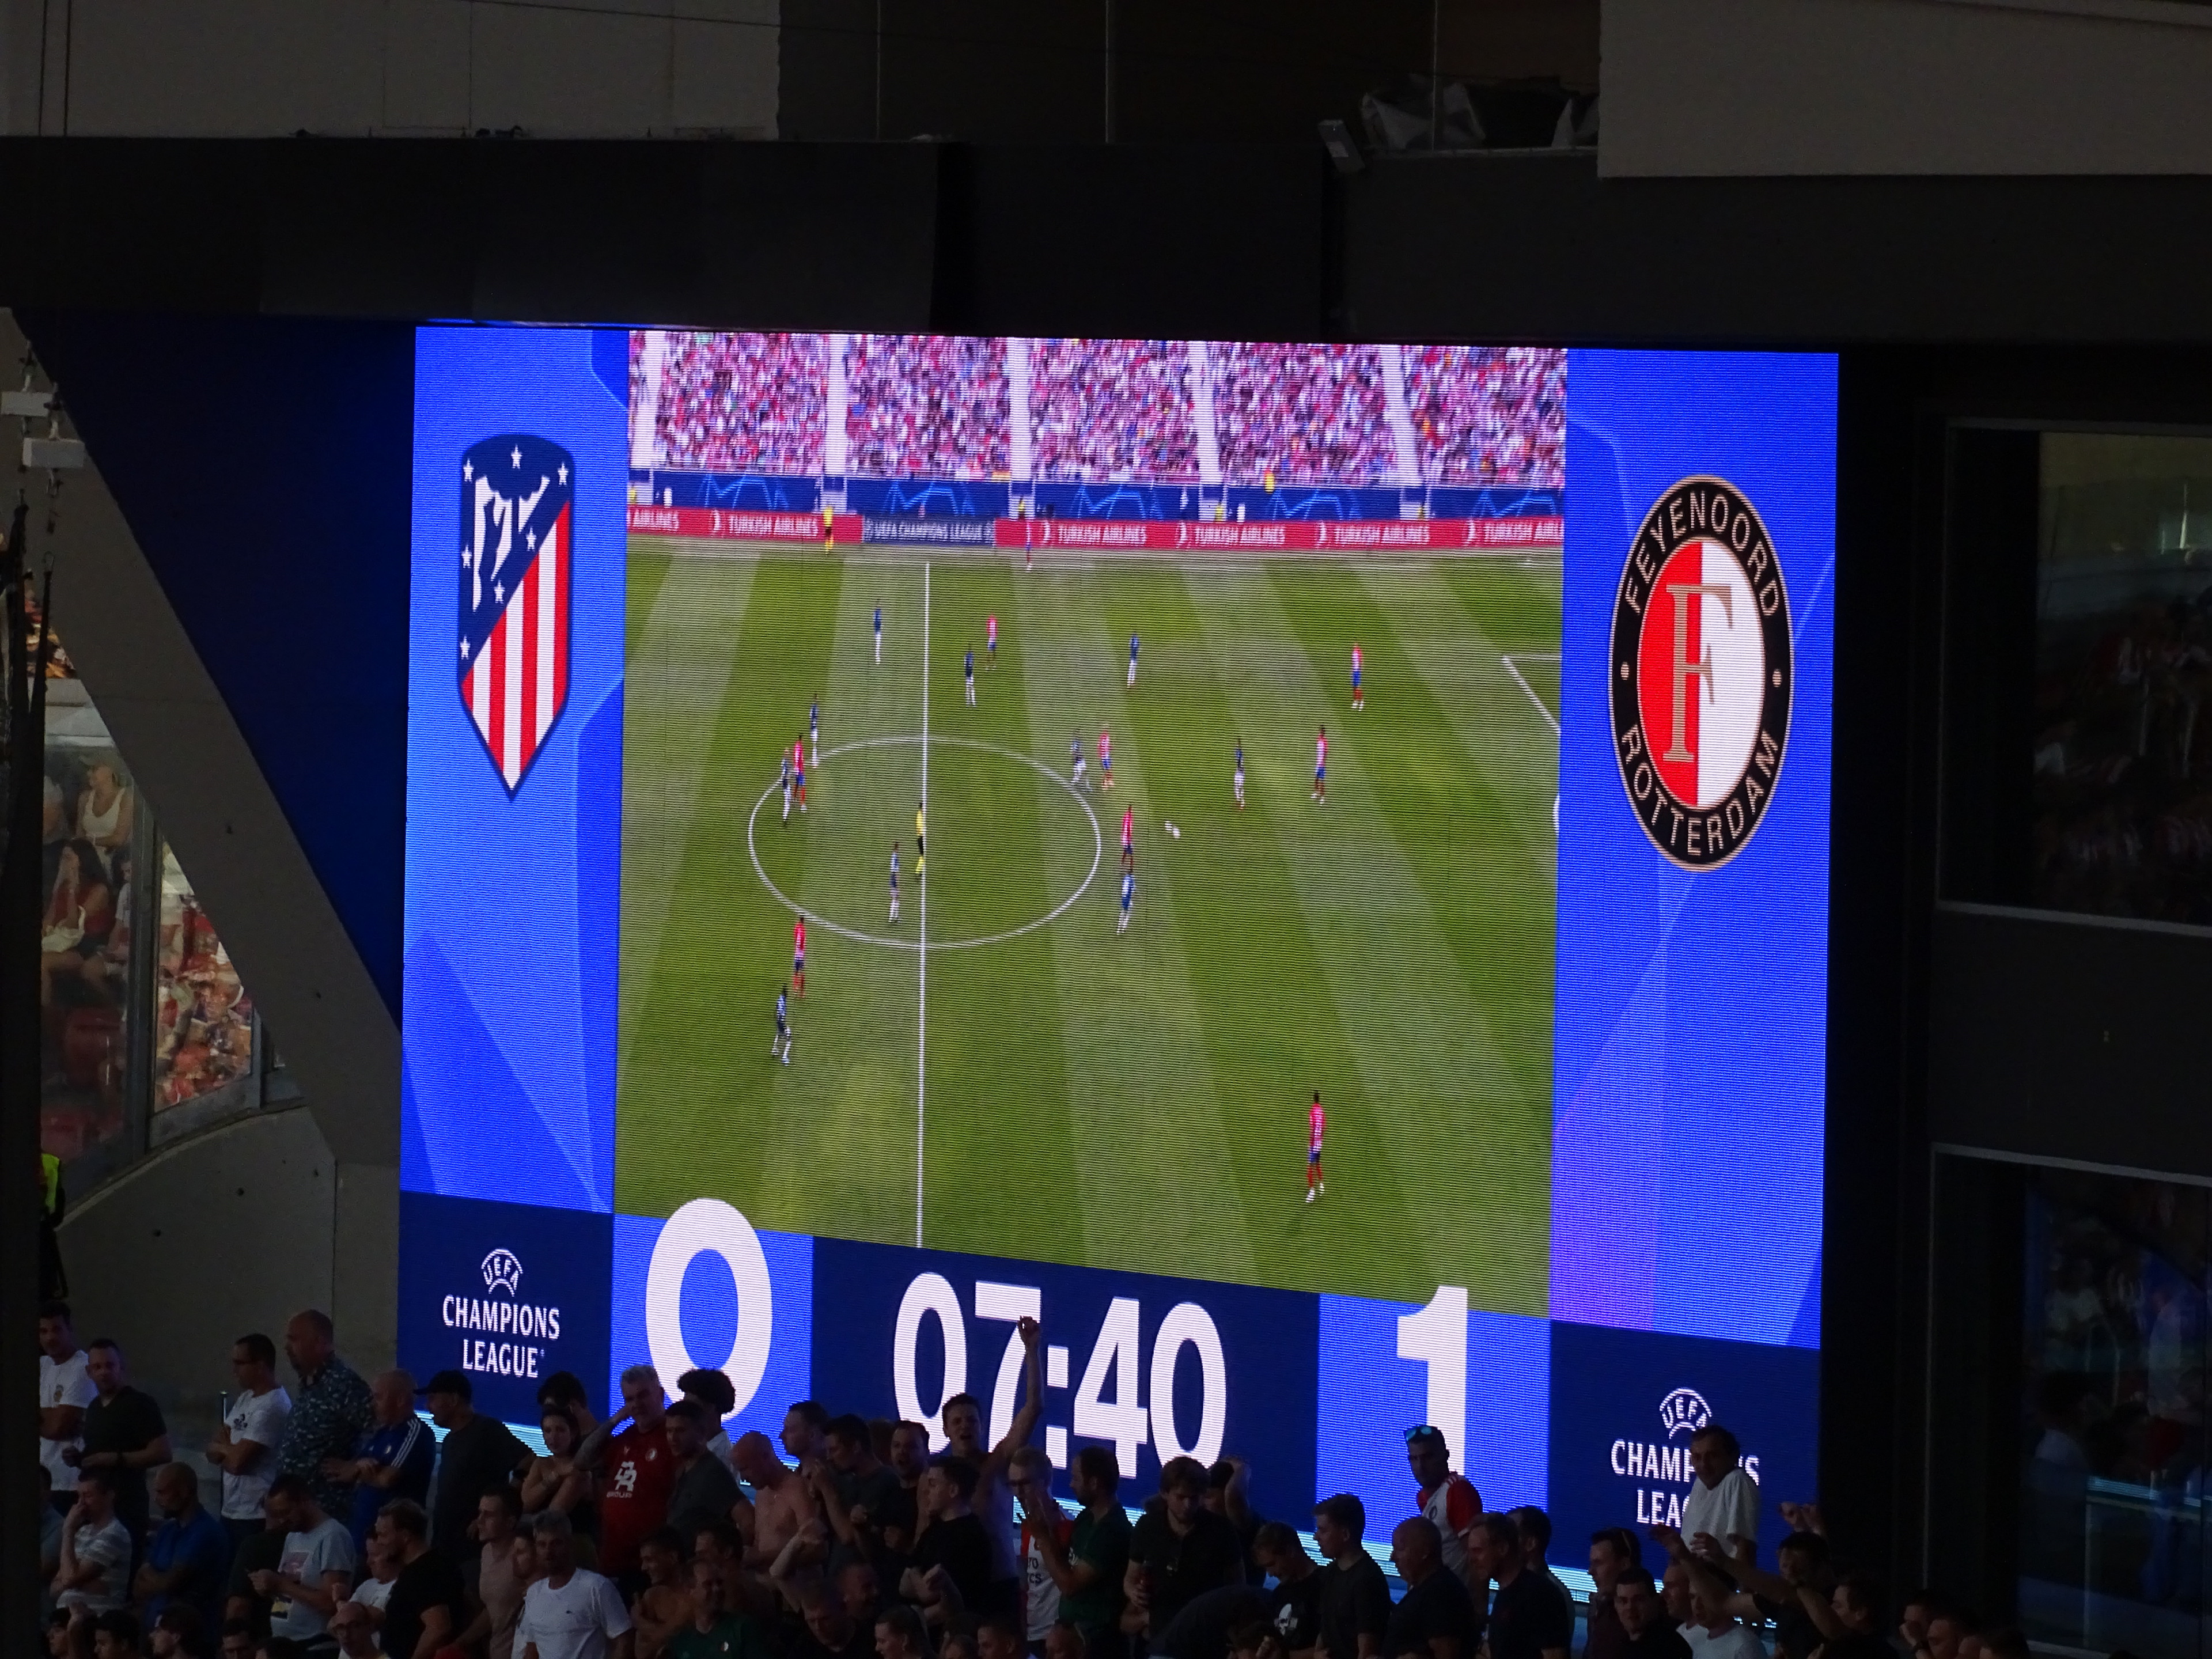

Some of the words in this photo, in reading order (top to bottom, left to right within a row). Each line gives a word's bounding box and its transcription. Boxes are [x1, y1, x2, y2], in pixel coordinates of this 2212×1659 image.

[632, 509, 680, 531] AIRLINES
[729, 514, 772, 535] TURKISH
[773, 516, 819, 538] AIRLINES
[1058, 525, 1101, 545] TURKISH
[1102, 525, 1146, 545] AIRLINES
[1195, 526, 1238, 547] TURKISH
[1240, 525, 1285, 546] AIRLINES
[1335, 525, 1380, 546] TURKISH
[1381, 525, 1429, 545] AIRLINES
[1484, 521, 1532, 542] TURKISH
[1625, 491, 1781, 617] FEYENOORD
[1662, 584, 1733, 763] F
[1621, 724, 1778, 855] ROTTERDAM
[483, 1256, 519, 1290] UEFA
[442, 1294, 560, 1340] CHAMPIONS
[645, 1198, 772, 1423] 0
[463, 1338, 539, 1378] LEAGUE
[893, 1272, 1226, 1479] 07:40
[1397, 1286, 1468, 1476] 1
[1661, 1396, 1707, 1429] UEFA
[1611, 1439, 1760, 1487] CHAMPS
